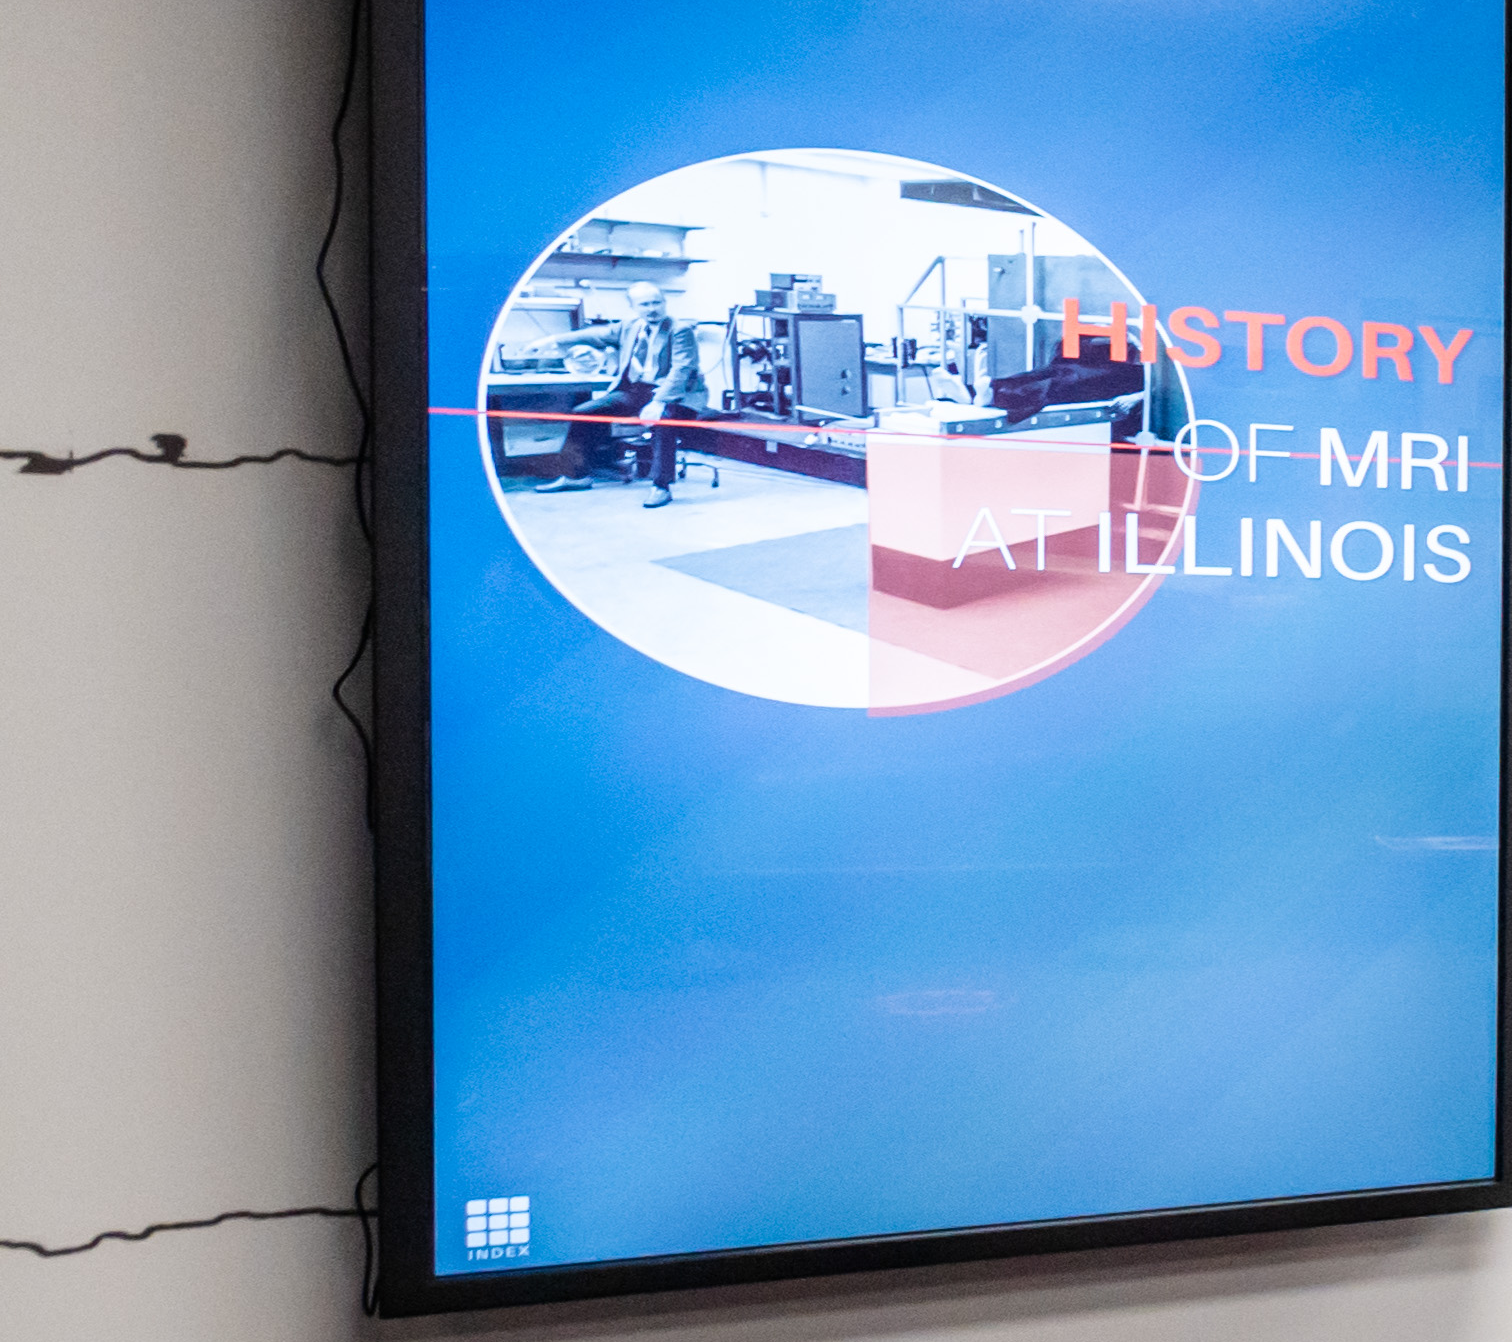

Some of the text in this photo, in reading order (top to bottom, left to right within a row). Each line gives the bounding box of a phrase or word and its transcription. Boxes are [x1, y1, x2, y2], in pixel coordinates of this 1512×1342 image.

[1062, 296, 1475, 385] HISTORY
[1172, 417, 1471, 492] OF MRI
[953, 507, 1471, 585] AT ILLINOIS
[467, 1243, 530, 1261] INDEX
